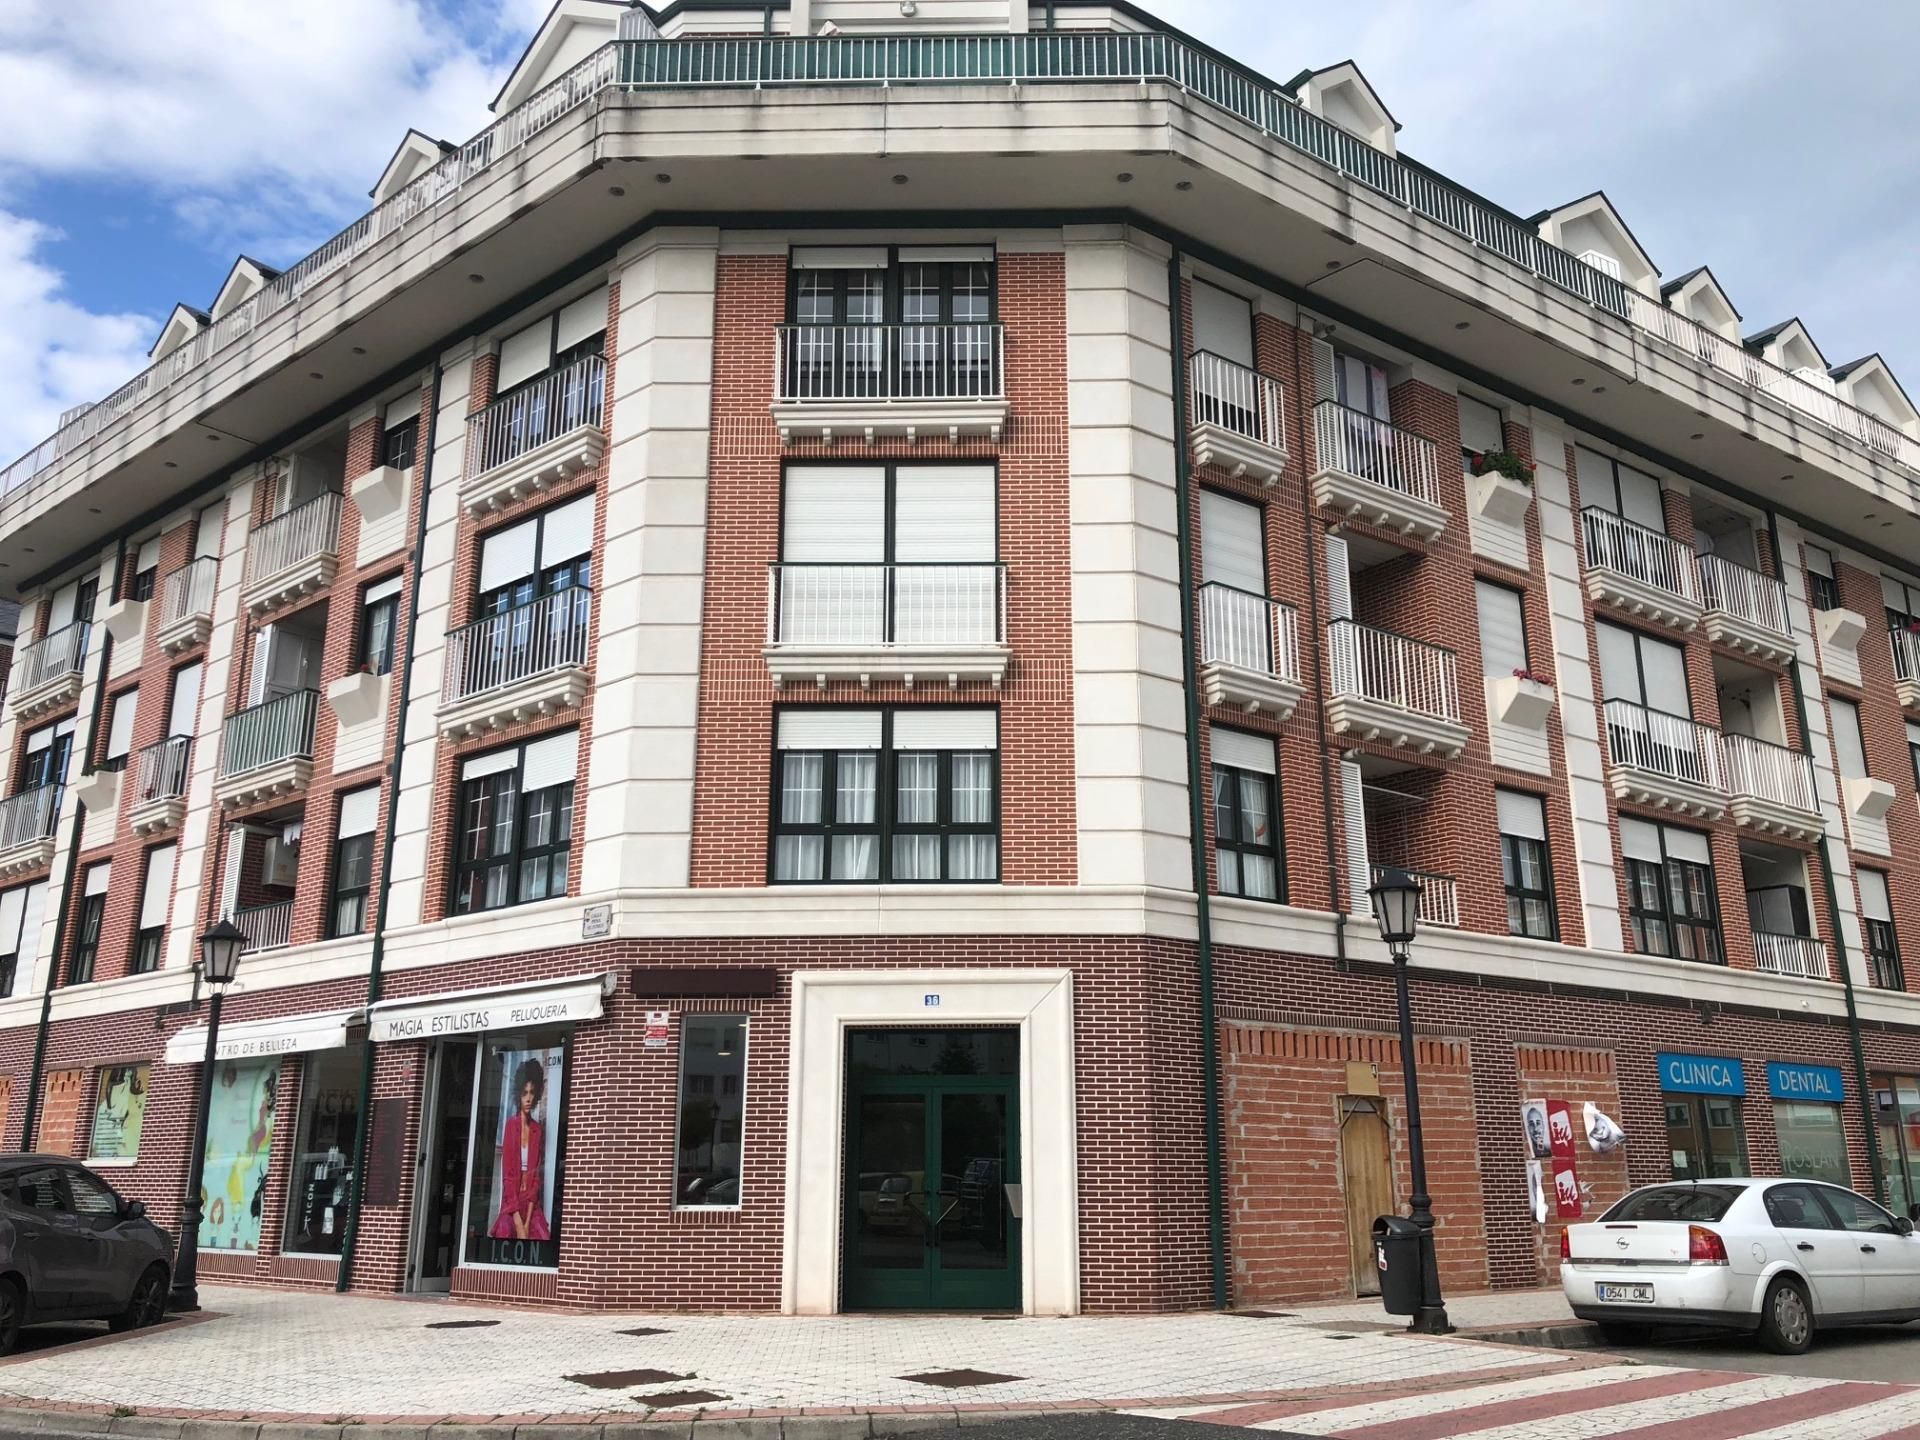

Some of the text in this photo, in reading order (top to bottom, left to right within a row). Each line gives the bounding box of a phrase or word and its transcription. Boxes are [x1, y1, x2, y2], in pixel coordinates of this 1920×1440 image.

[926, 995, 938, 1005] 36
[510, 1004, 568, 1022] PELUQUERIA
[389, 1011, 490, 1037] MAGIA ESTILISTAS
[242, 1044, 255, 1054] DE
[259, 1038, 298, 1052] BELLEZA
[1669, 1061, 1833, 1094] CLINICA DENTAL
[1606, 1287, 1650, 1299] 0541 CML
